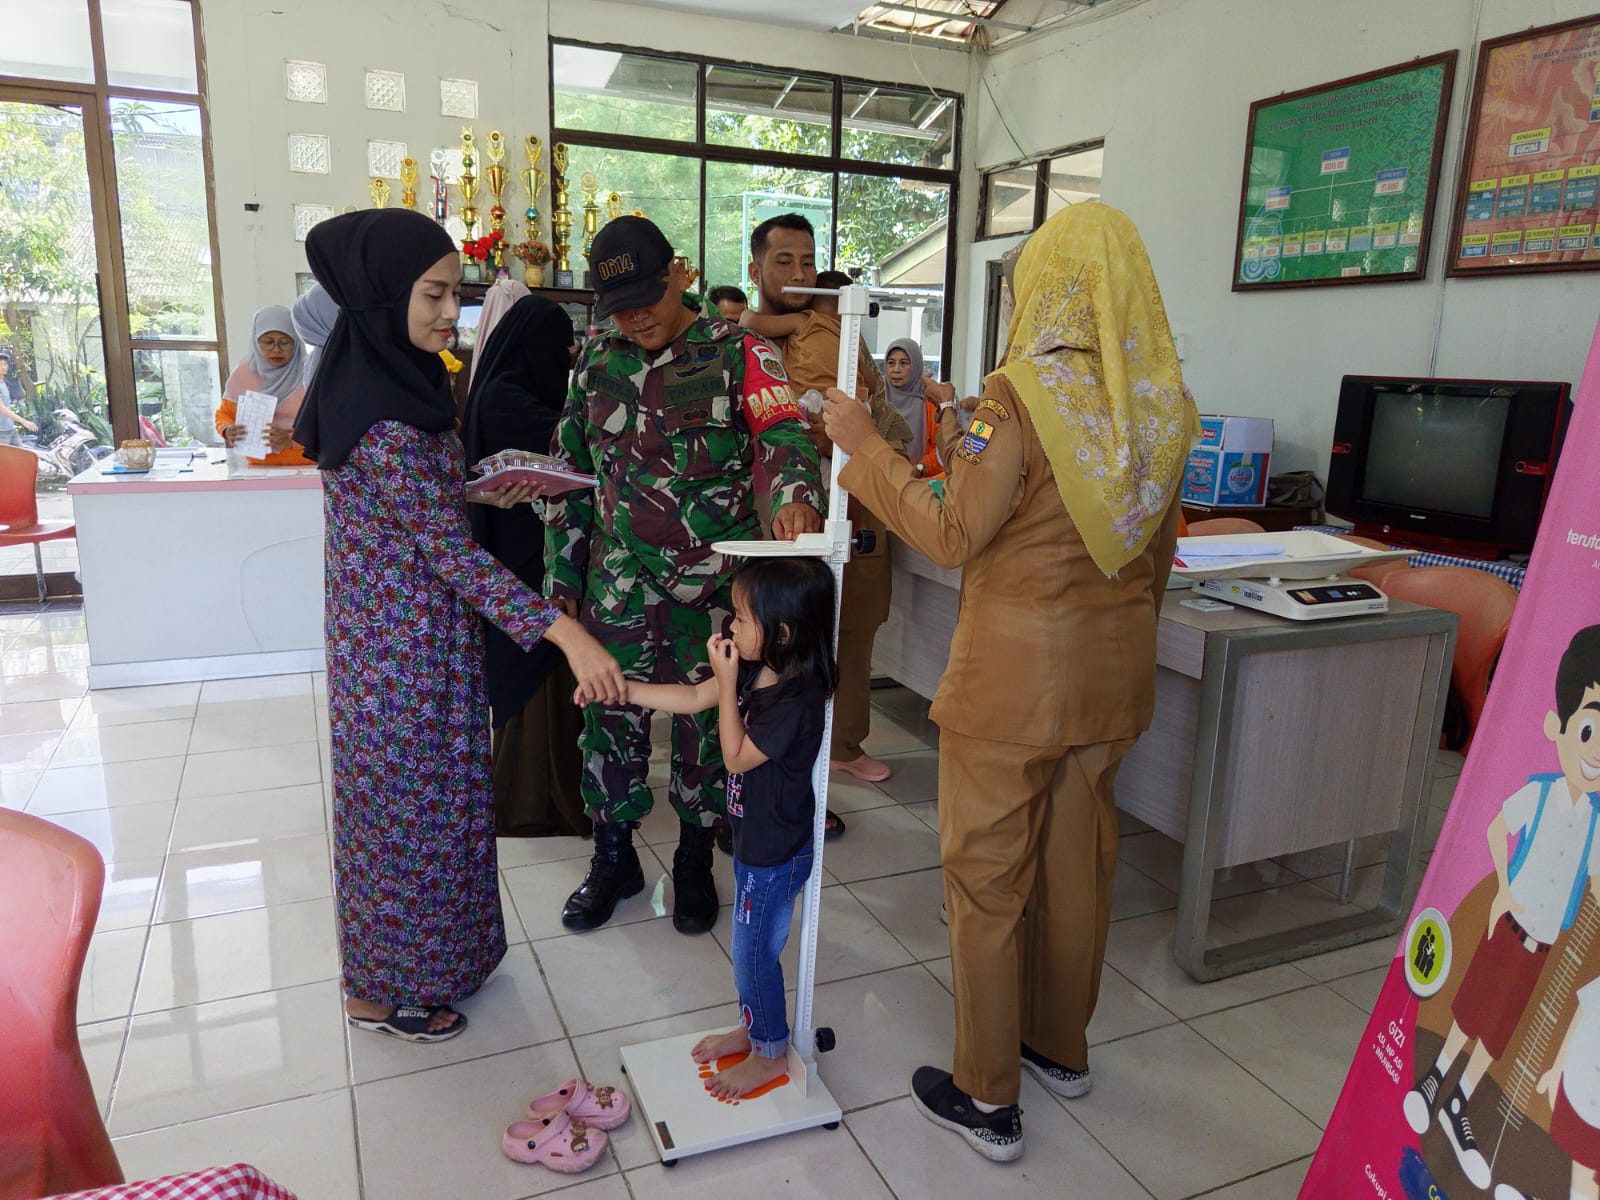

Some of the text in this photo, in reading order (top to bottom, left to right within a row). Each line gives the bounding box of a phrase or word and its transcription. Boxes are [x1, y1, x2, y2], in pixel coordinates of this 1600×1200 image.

[599, 253, 634, 280] 0614
[747, 384, 796, 419] BABI
[1388, 1020, 1406, 1048] GIZI
[1393, 1055, 1404, 1071] ASI
[1364, 1163, 1388, 1200] Cukupi
